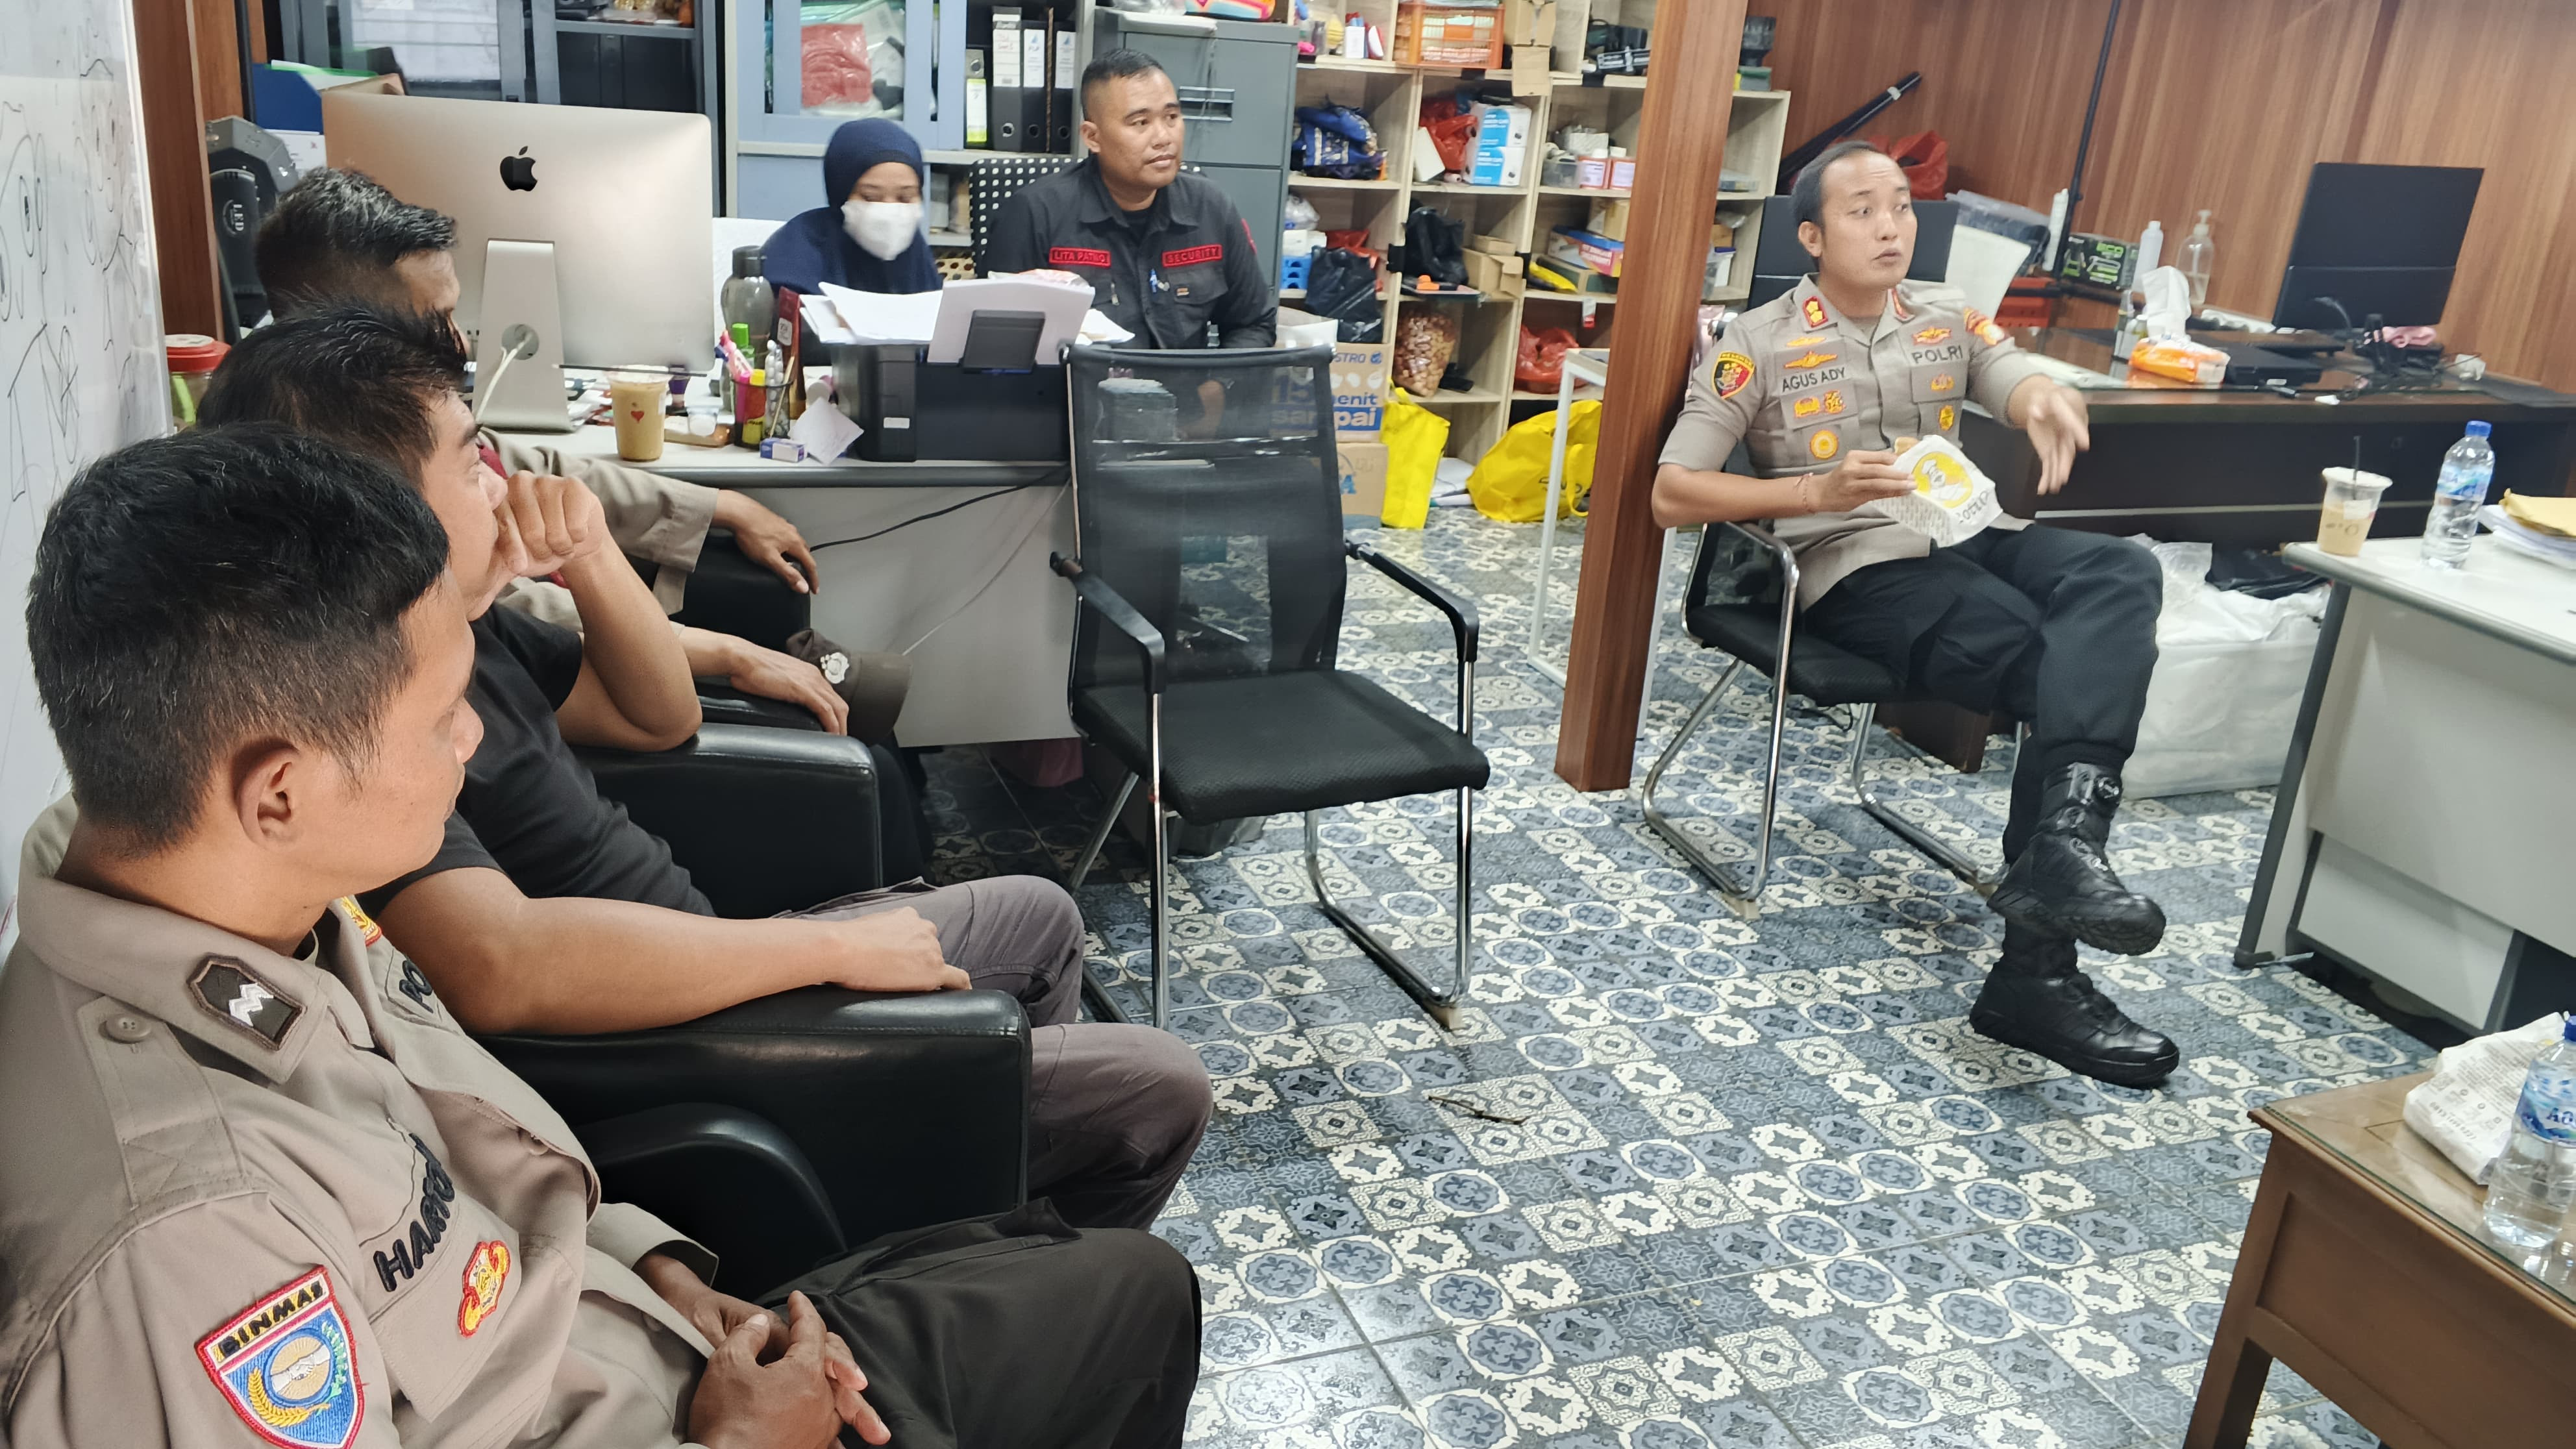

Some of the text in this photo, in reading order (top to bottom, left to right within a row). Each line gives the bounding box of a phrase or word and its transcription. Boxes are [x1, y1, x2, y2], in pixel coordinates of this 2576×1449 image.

[234, 204, 244, 231] LED
[1167, 247, 1217, 263] SECURITY
[1334, 353, 1366, 363] STRO
[1912, 345, 1964, 364] POLRI
[1782, 367, 1846, 392] AGUS ADY
[1332, 391, 1378, 405] enit
[399, 957, 434, 1014] PO
[217, 1280, 323, 1359] BINMAS
